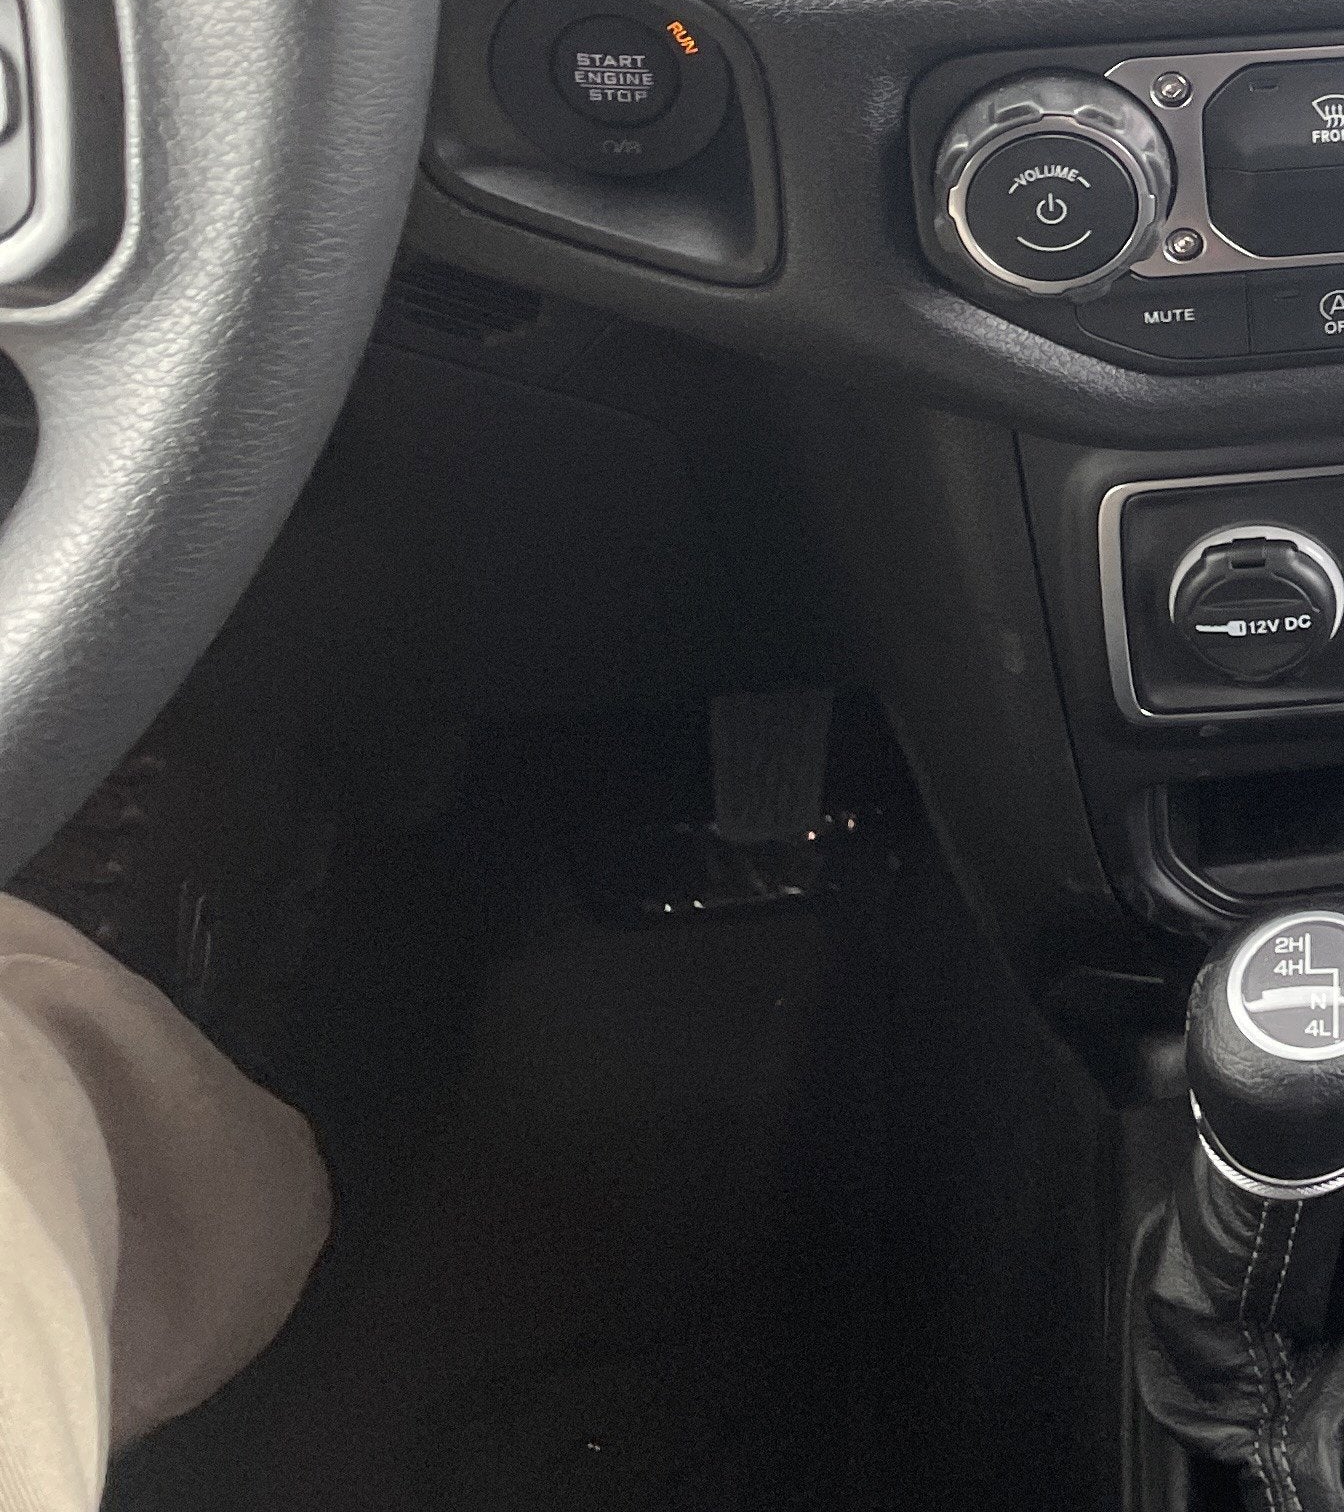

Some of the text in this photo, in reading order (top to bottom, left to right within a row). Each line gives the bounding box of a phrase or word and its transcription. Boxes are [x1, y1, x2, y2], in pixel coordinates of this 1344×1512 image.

[666, 19, 699, 56] RUN
[576, 53, 646, 69] START
[574, 70, 655, 86] ENGINE
[588, 88, 649, 103] STOP
[1013, 164, 1080, 187] VOLUME
[1143, 307, 1196, 324] MUTE
[1248, 612, 1313, 636] 12V DC
[1274, 937, 1305, 954] 2H
[1273, 959, 1305, 976] 4H
[1309, 992, 1328, 1010] N
[1304, 1019, 1332, 1037] 4L
